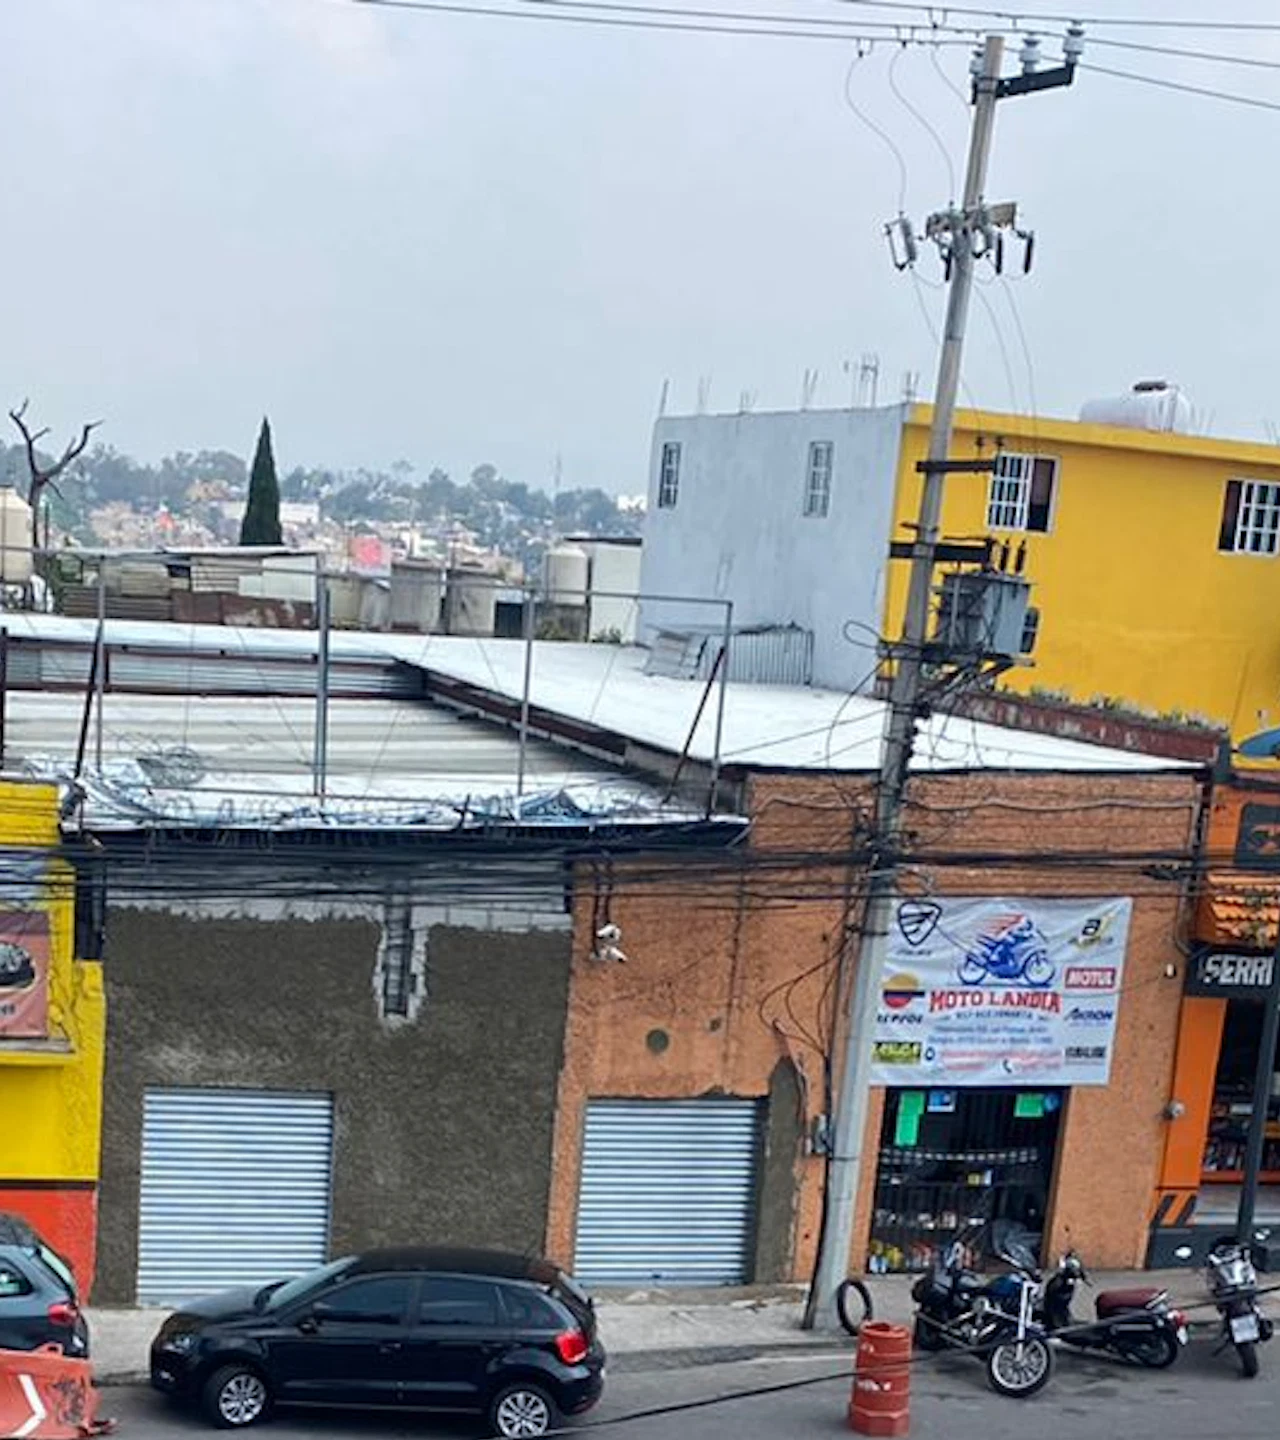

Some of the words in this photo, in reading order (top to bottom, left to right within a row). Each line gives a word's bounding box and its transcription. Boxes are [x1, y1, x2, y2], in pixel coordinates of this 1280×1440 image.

[1067, 969, 1113, 986] MOTUL
[928, 990, 983, 1013] MOTO
[990, 991, 1061, 1014] LANDIA
